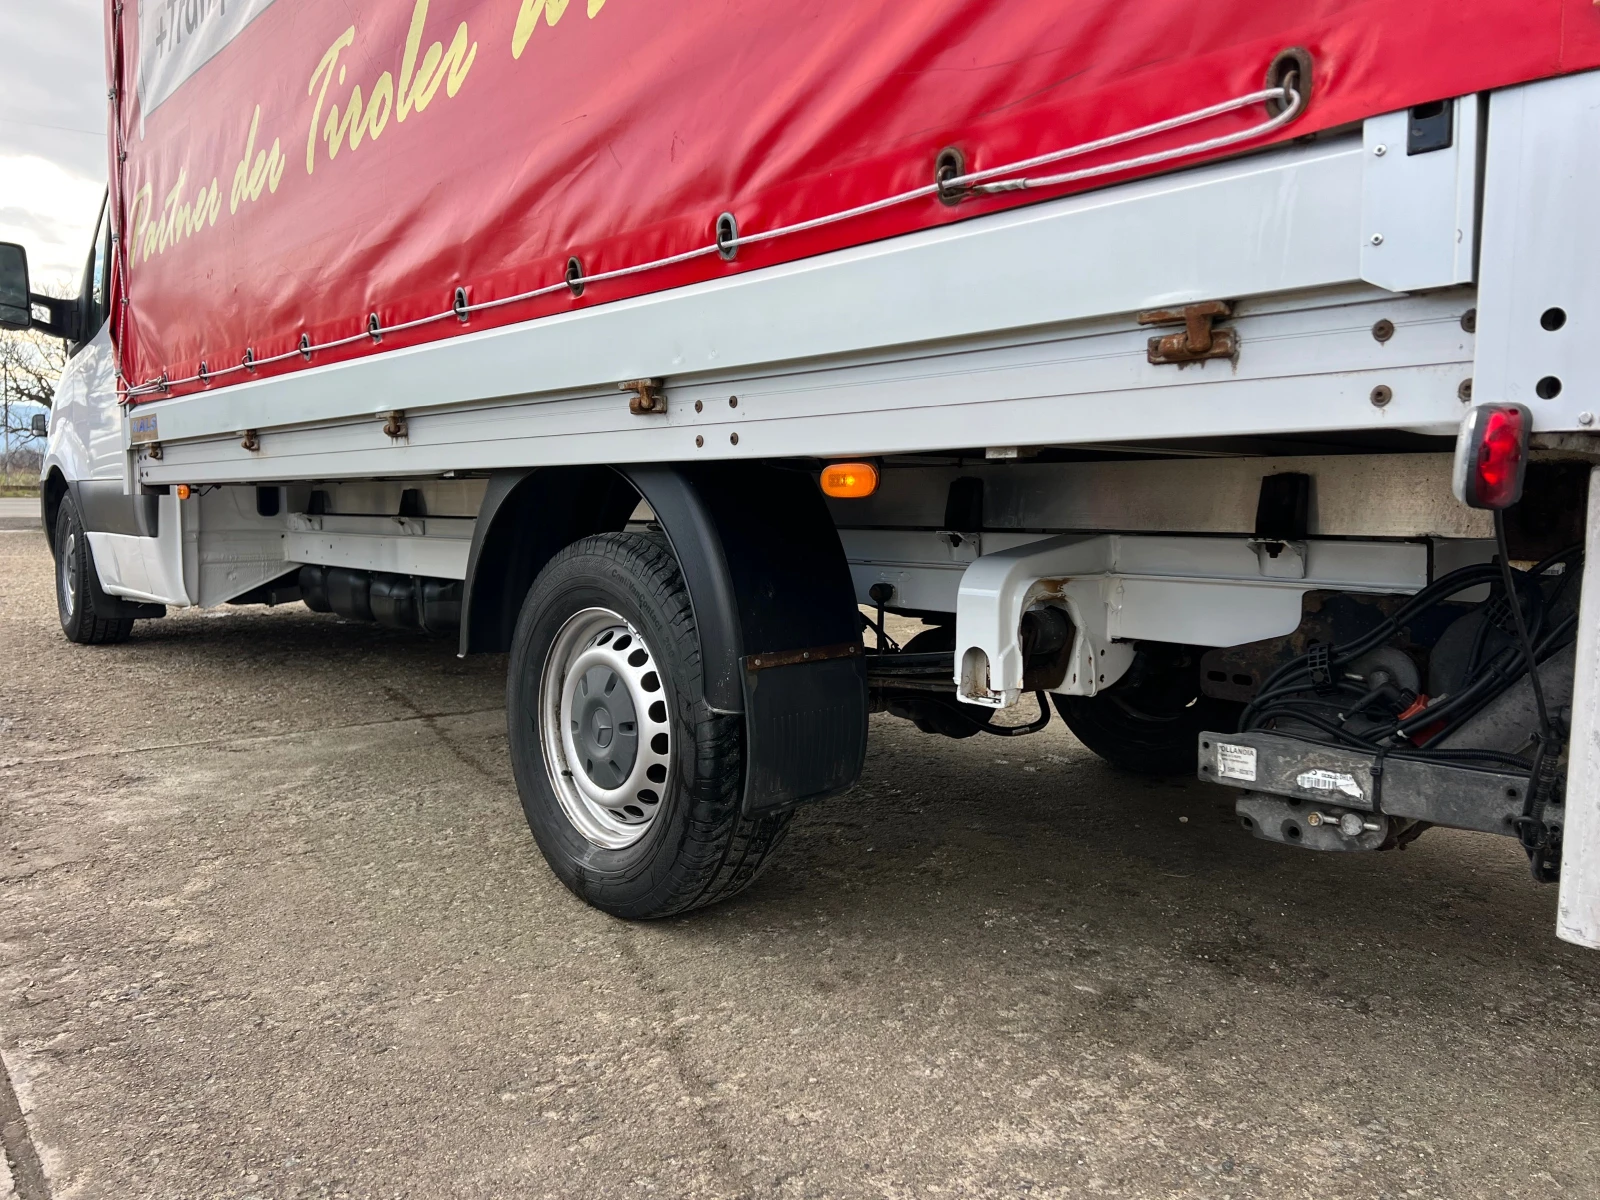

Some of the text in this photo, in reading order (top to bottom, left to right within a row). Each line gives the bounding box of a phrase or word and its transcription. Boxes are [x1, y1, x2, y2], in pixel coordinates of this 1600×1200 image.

[129, 166, 222, 270] Partner
[230, 104, 286, 215] der
[306, 0, 479, 174] Tiroler
[611, 568, 664, 633] ContiVanContact
